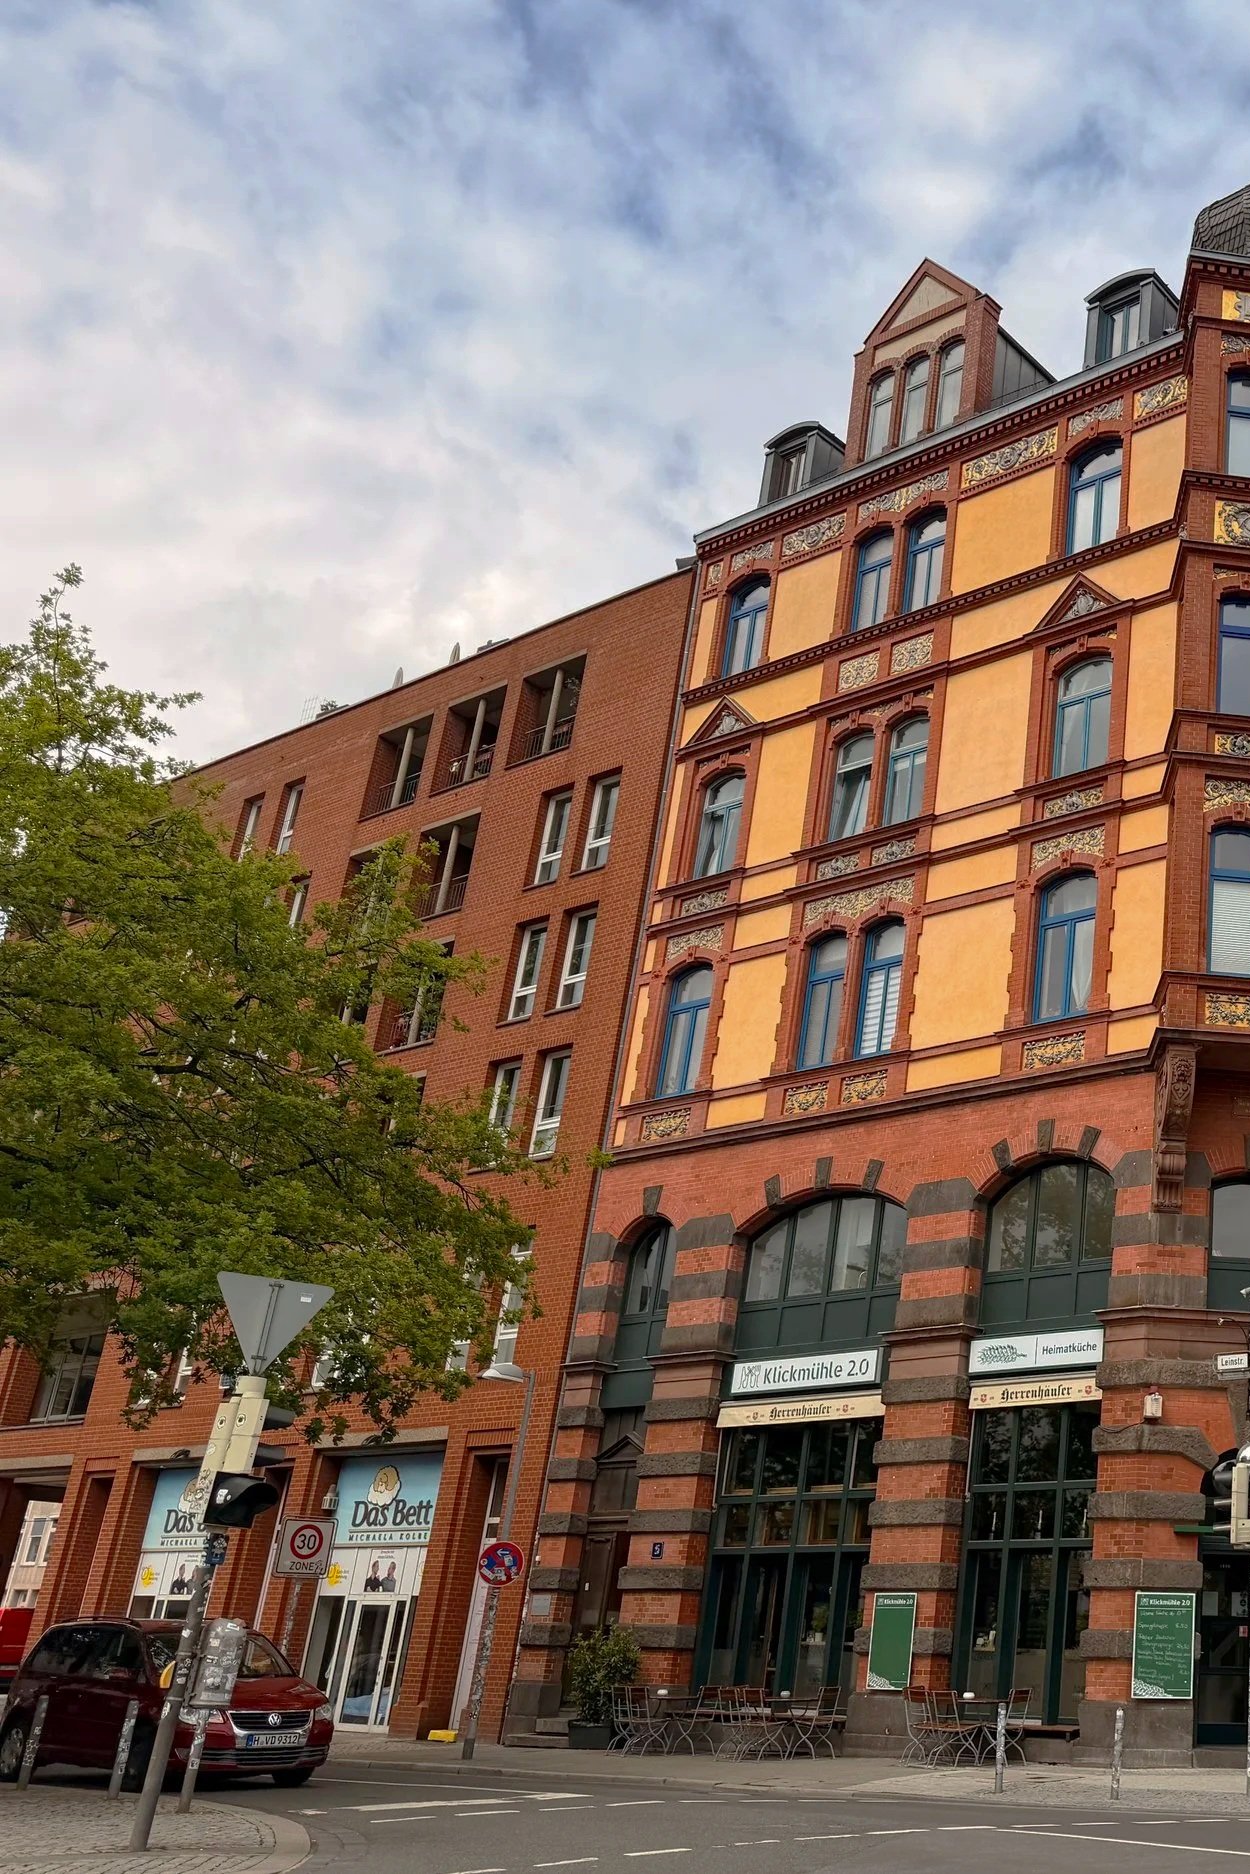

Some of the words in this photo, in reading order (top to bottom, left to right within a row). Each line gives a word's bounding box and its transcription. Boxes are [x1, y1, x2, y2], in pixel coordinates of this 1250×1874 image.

[1041, 1342, 1098, 1356] Heimatküche
[1221, 1357, 1245, 1366] Leinstr.
[763, 1361, 842, 1384] Klickmühle
[847, 1358, 869, 1377] 2.0
[351, 1500, 389, 1527] Das
[391, 1499, 433, 1526] Bett
[163, 1509, 195, 1534] Das
[160, 1538, 198, 1547] MICHAELA
[297, 1533, 317, 1550] 30
[349, 1533, 393, 1542] MICHAELA
[289, 1561, 315, 1571] ZONE
[253, 1736, 260, 1746] H
[265, 1736, 277, 1745] VD
[277, 1735, 298, 1745] 9312
